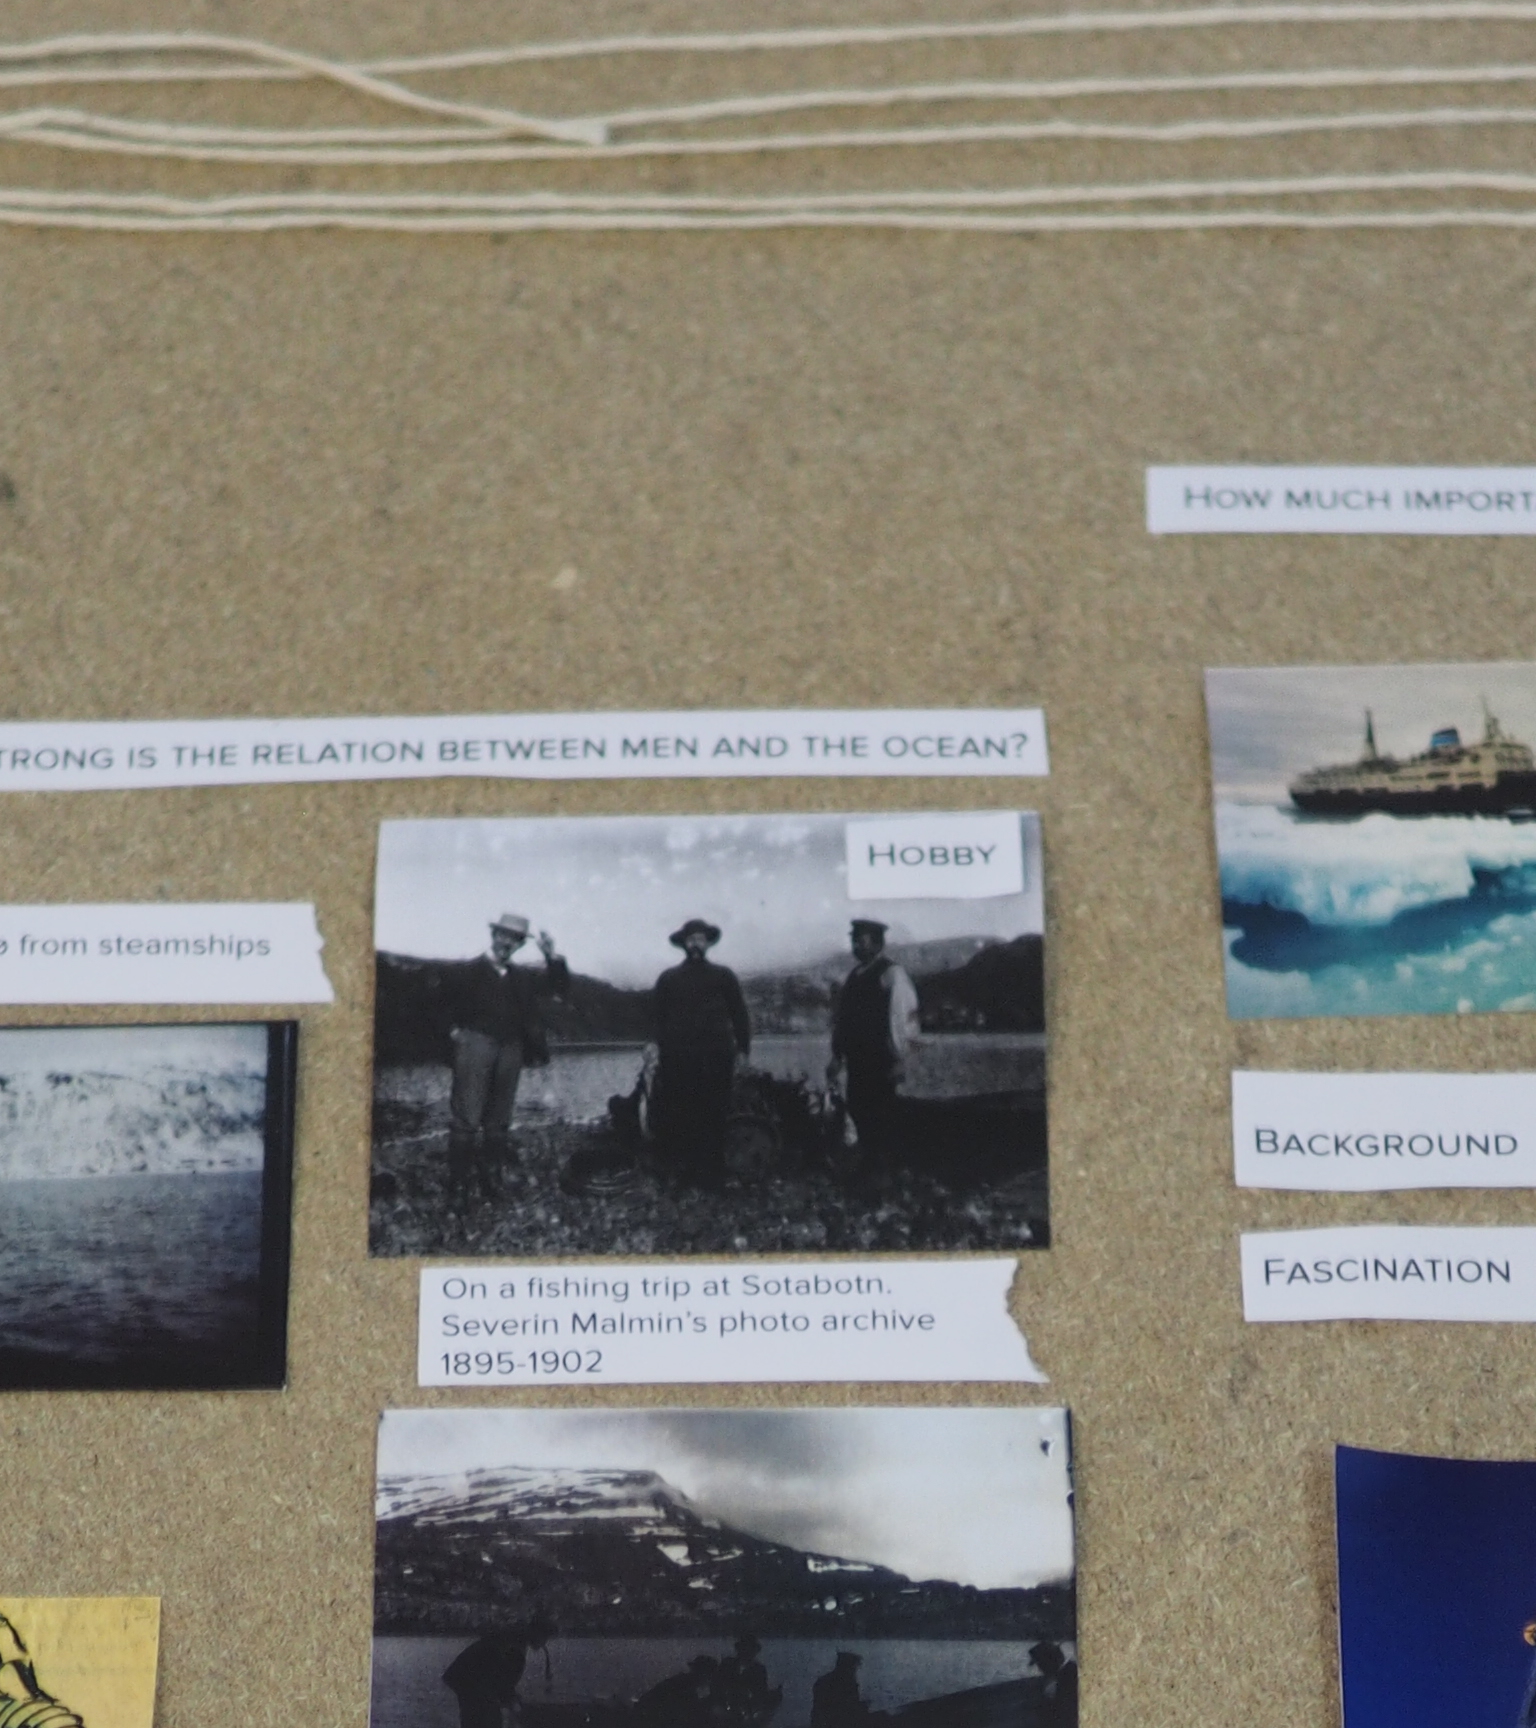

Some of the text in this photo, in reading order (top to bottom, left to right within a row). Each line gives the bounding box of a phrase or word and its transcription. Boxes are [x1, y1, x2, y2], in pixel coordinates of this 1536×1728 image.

[1183, 486, 1272, 510] HOW
[1284, 488, 1392, 511] MUCH
[127, 747, 158, 769] IS
[172, 744, 237, 767] THE
[251, 740, 425, 765] RELATION
[438, 737, 607, 762] BETWEEN
[620, 736, 699, 759] MEN
[711, 735, 790, 759] AND
[802, 735, 868, 758] THE
[881, 731, 1029, 759] OCEAN?
[867, 842, 996, 868] HOBBY
[19, 933, 88, 956] from
[98, 933, 272, 962] steamships
[1254, 1127, 1519, 1158] BACKGROUND
[1263, 1257, 1511, 1287] FASCINATION
[441, 1273, 892, 1302] On a fishing trip at Sotabotn.
[441, 1308, 936, 1338] Severin Malmin's photo archive
[441, 1349, 603, 1376] 1895-1902
